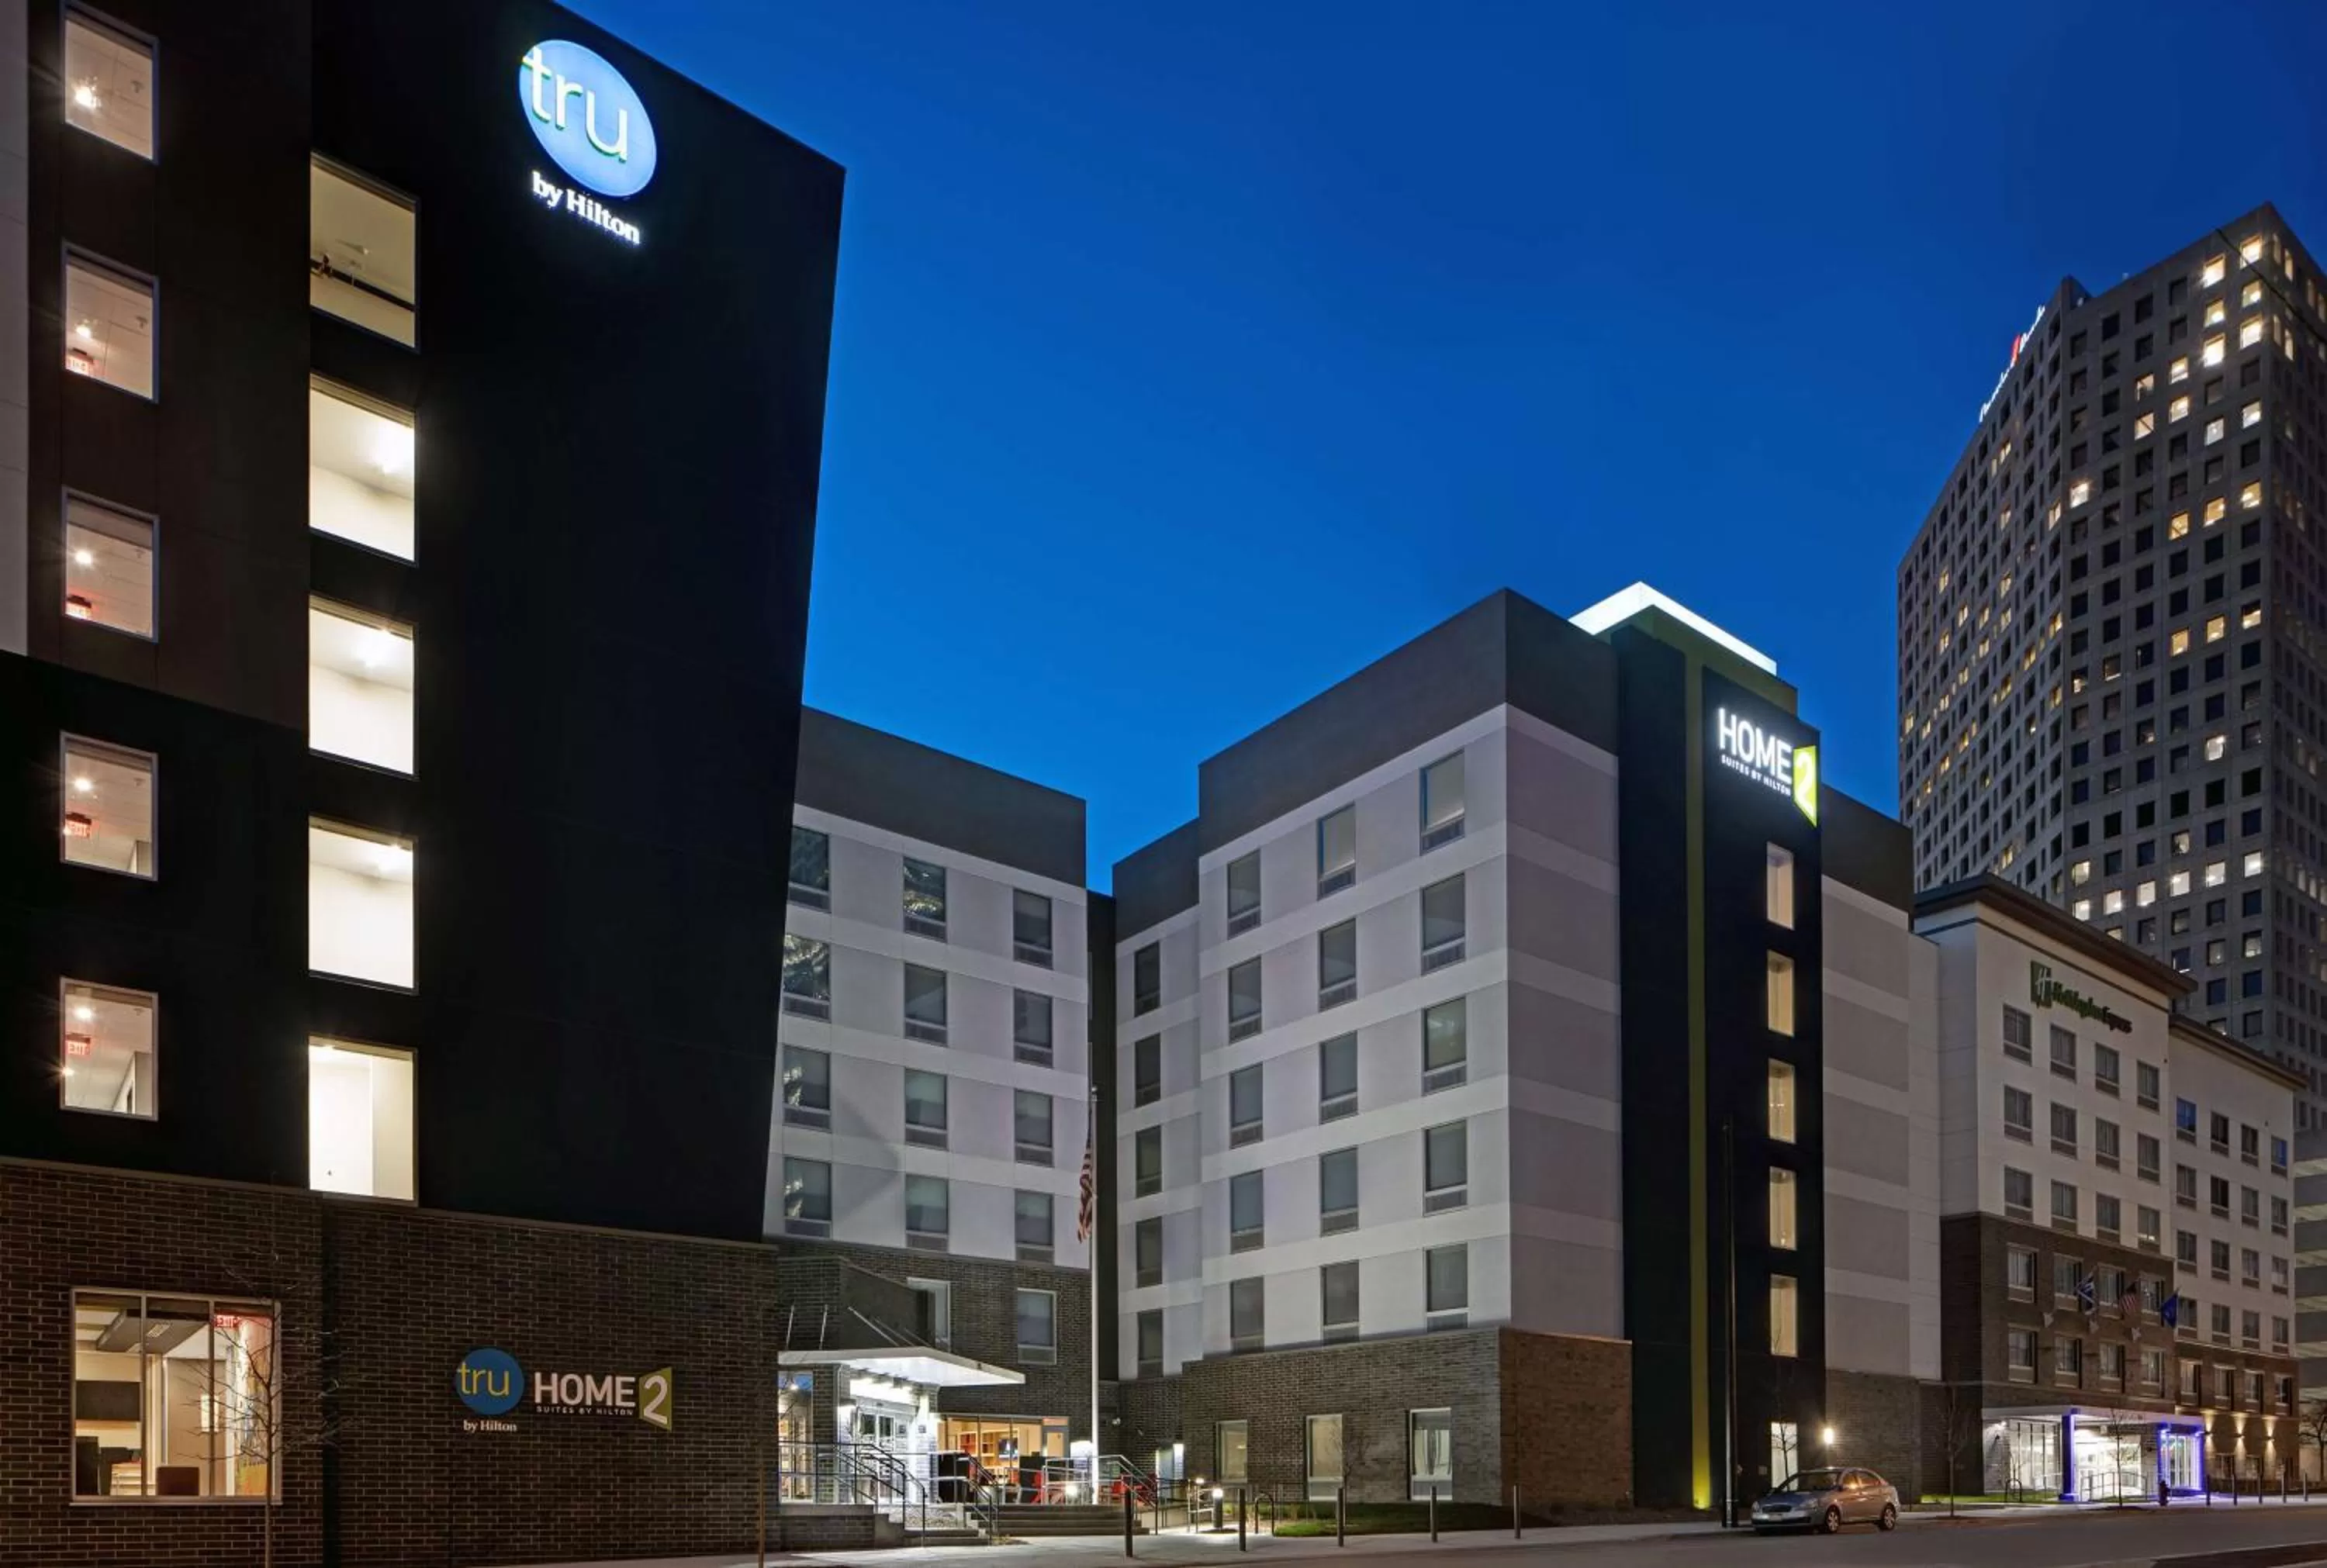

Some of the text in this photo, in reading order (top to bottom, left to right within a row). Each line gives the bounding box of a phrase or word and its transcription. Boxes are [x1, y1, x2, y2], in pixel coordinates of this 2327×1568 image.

[522, 45, 628, 164] tru
[532, 170, 641, 245] by Hilton
[1718, 707, 1815, 817] HOME 2
[1720, 754, 1791, 796] SUITES BY HILTON
[68, 1041, 85, 1055] EXIT
[216, 1314, 234, 1328] EXIT
[457, 1361, 510, 1397] tru
[534, 1372, 668, 1425] HOME 2
[463, 1420, 517, 1433] by Hilton
[536, 1405, 573, 1414] SUITES
[596, 1407, 634, 1416] HILTON
